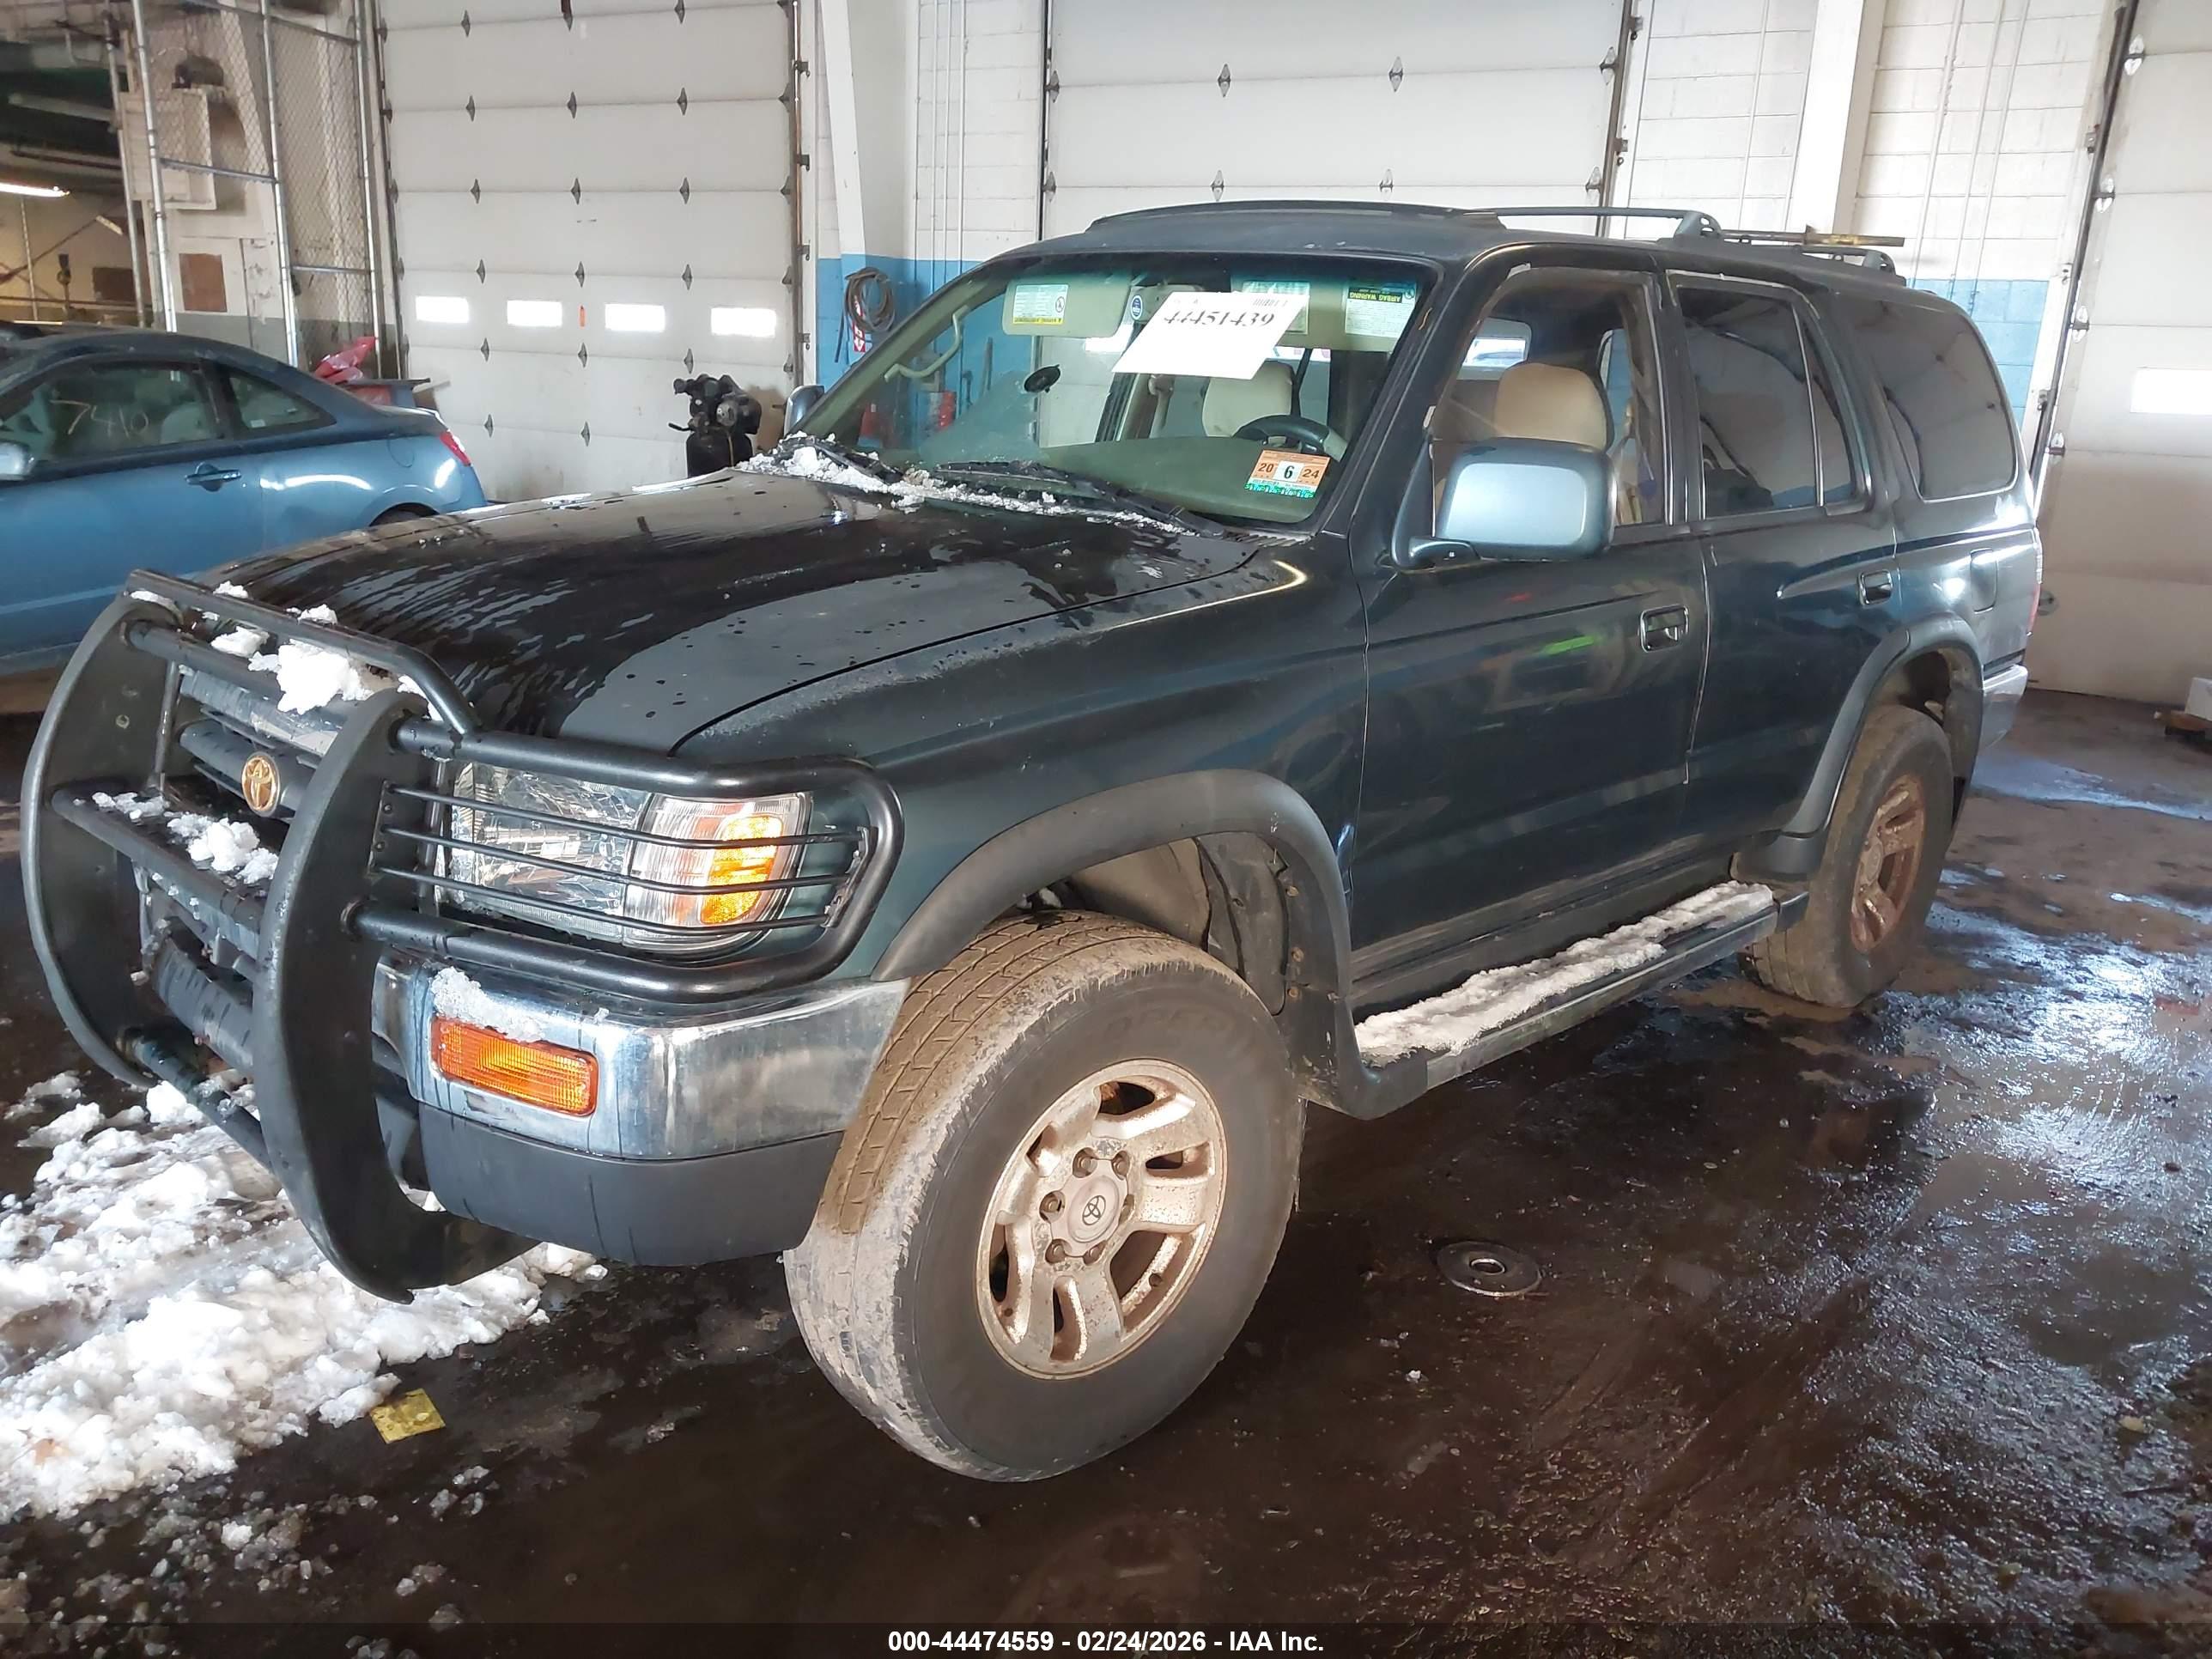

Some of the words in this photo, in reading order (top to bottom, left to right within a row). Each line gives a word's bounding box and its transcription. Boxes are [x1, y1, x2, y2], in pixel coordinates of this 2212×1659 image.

[1258, 463, 1274, 473] 20
[1284, 465, 1295, 479] 6
[1302, 468, 1320, 478] 24
